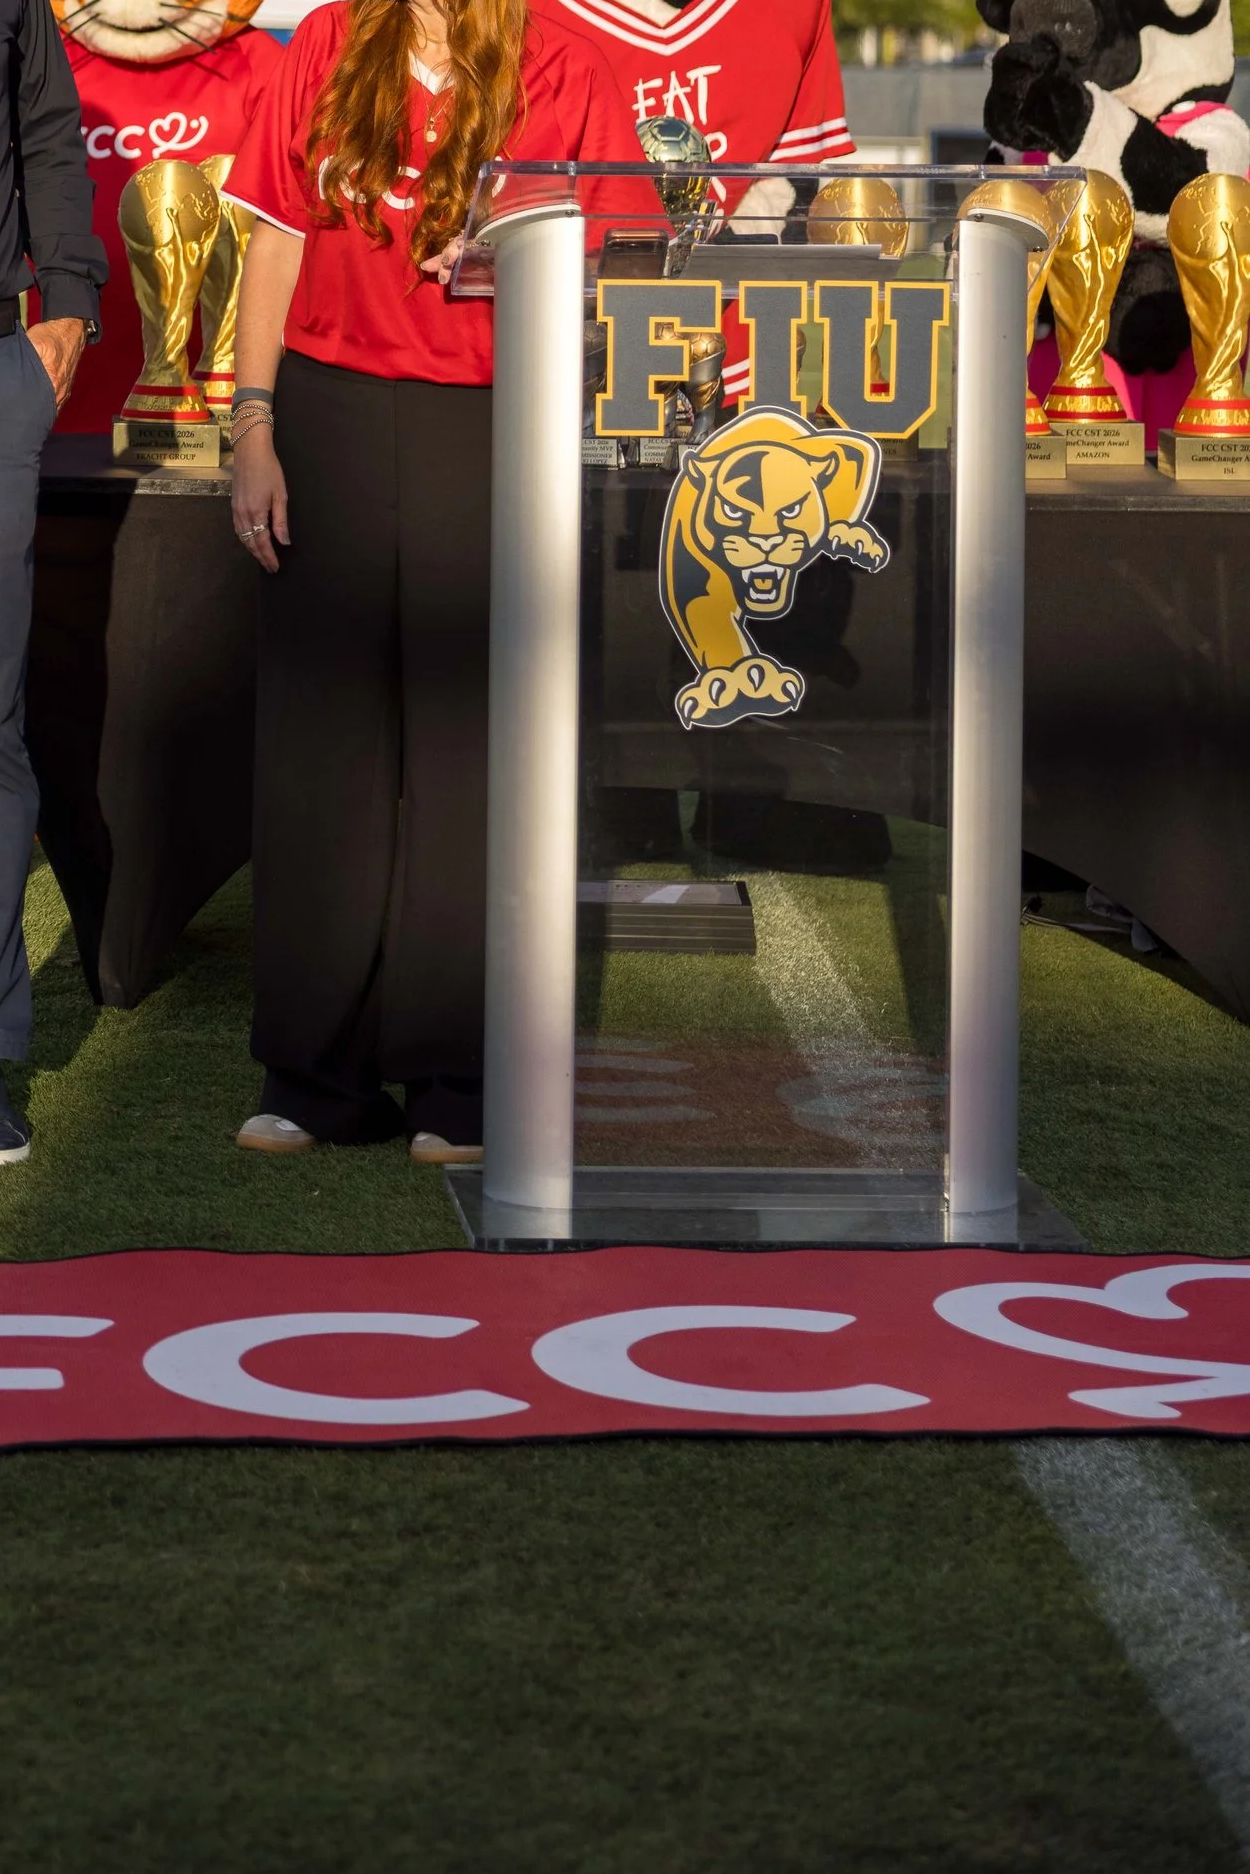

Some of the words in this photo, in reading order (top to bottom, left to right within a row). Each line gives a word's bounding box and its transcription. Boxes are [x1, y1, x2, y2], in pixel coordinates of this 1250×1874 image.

[632, 65, 722, 126] EAT
[81, 125, 146, 159] CC
[596, 279, 950, 439] FIU
[176, 430, 195, 438] 2026
[1066, 429, 1082, 437] FCC
[1084, 429, 1101, 437] CST
[1103, 429, 1120, 437] 2026
[180, 441, 204, 449] Award
[1026, 442, 1041, 450] 026
[1066, 440, 1105, 448] meChanger
[1201, 444, 1219, 452] FCC
[1220, 444, 1237, 452] CST
[169, 453, 196, 461] GROUP
[1191, 455, 1242, 464] GameChanger
